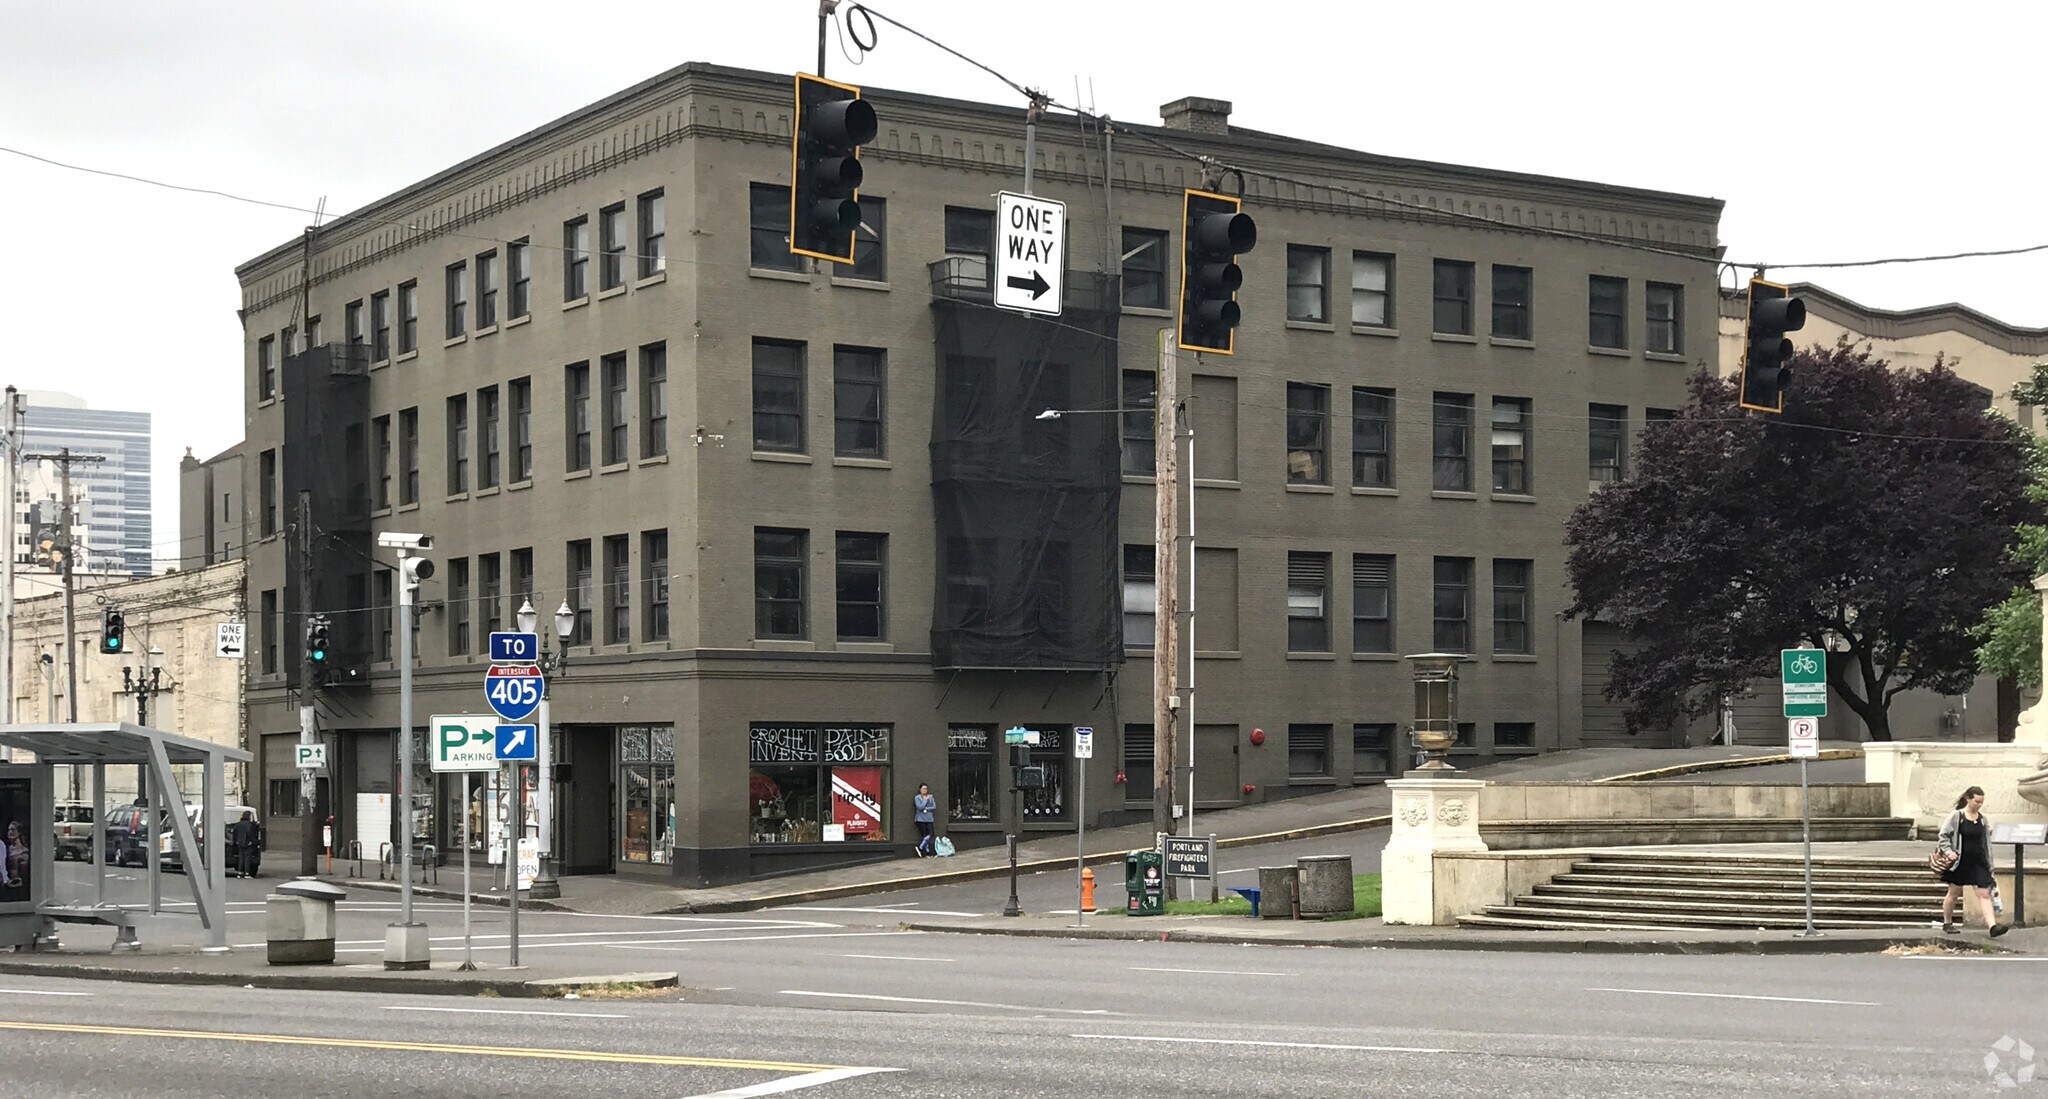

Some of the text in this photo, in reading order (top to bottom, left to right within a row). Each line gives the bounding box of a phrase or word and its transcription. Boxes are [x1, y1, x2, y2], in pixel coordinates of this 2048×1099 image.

[1011, 204, 1053, 235] ONE
[1009, 234, 1054, 264] WAY
[221, 625, 241, 634] ONE
[220, 635, 241, 643] WAY
[502, 639, 525, 655] TO
[497, 668, 530, 676] INTERSTATE
[491, 679, 537, 705] 405
[749, 728, 888, 752] CROCHET PAINT
[750, 740, 888, 761] INVENT DOODLE
[1172, 843, 1204, 852] PORTLAND
[1168, 853, 1208, 863] FIREFIGHTERS
[1180, 864, 1196, 873] PARK
